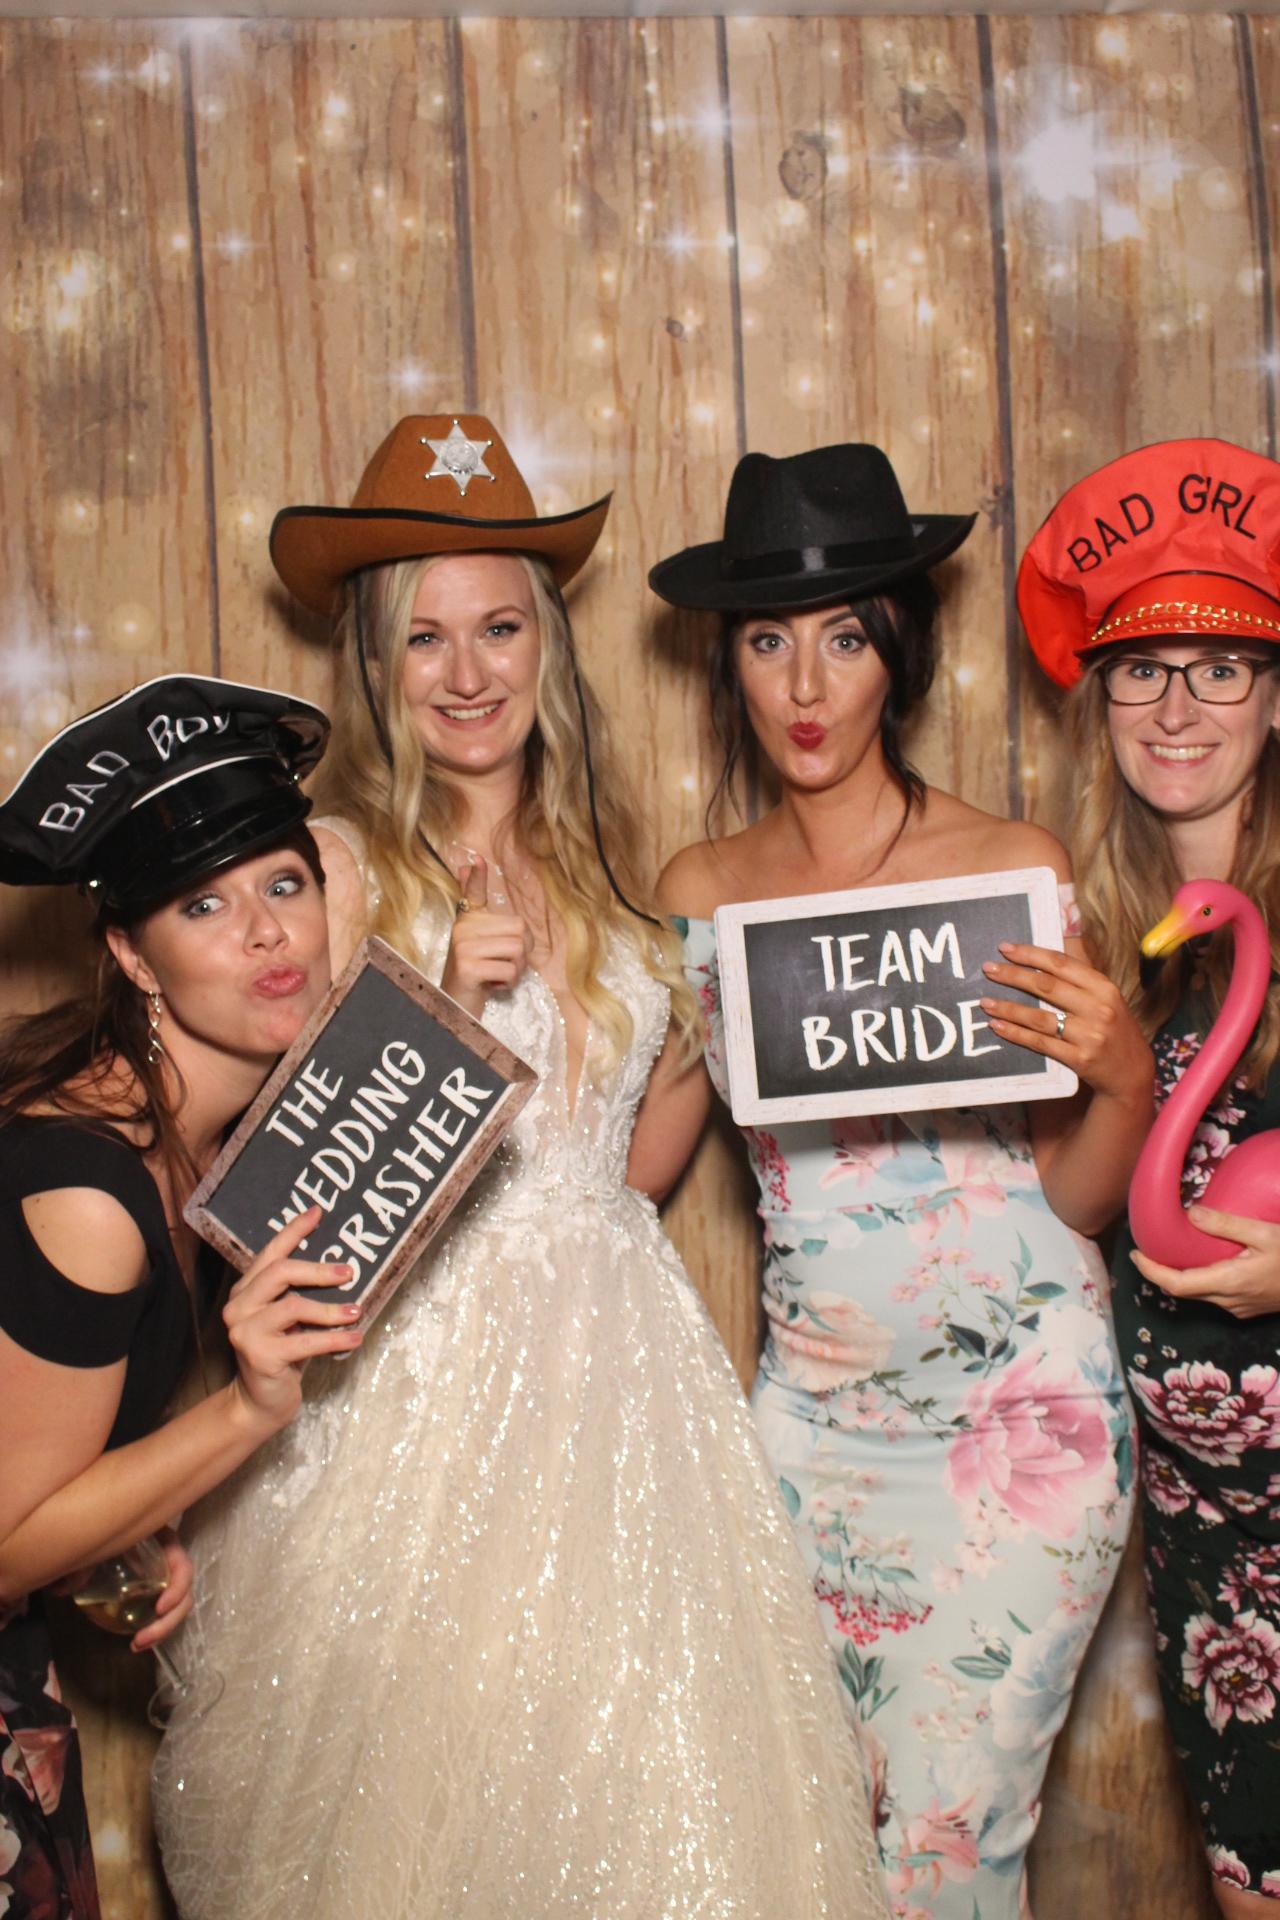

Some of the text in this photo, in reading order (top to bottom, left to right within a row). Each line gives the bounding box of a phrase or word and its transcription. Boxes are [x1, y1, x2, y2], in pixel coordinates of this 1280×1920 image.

[1066, 493, 1155, 573] BAD
[39, 712, 231, 833] BAD BOY
[811, 922, 965, 991] TEAM
[801, 999, 1003, 1071] BRIDE
[265, 1058, 343, 1146] THE
[318, 1066, 494, 1292] CRASHER
